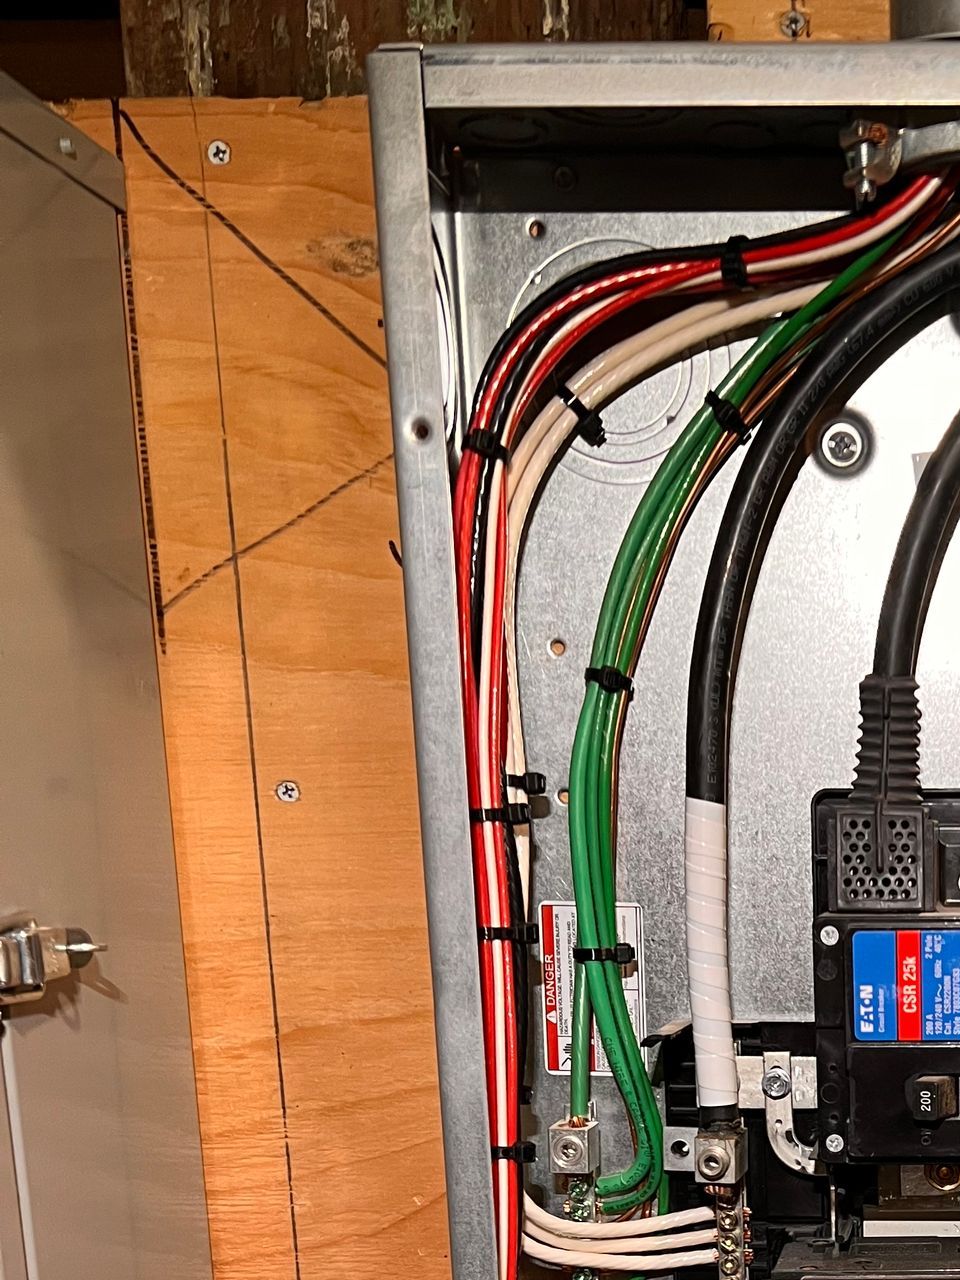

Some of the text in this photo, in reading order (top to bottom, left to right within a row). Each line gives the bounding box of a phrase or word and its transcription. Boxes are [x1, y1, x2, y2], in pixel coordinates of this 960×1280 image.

[544, 954, 556, 1006] DANGER
[903, 956, 917, 1013] CSR 25k
[859, 985, 874, 1033] EATON
[920, 1090, 932, 1112] 200
